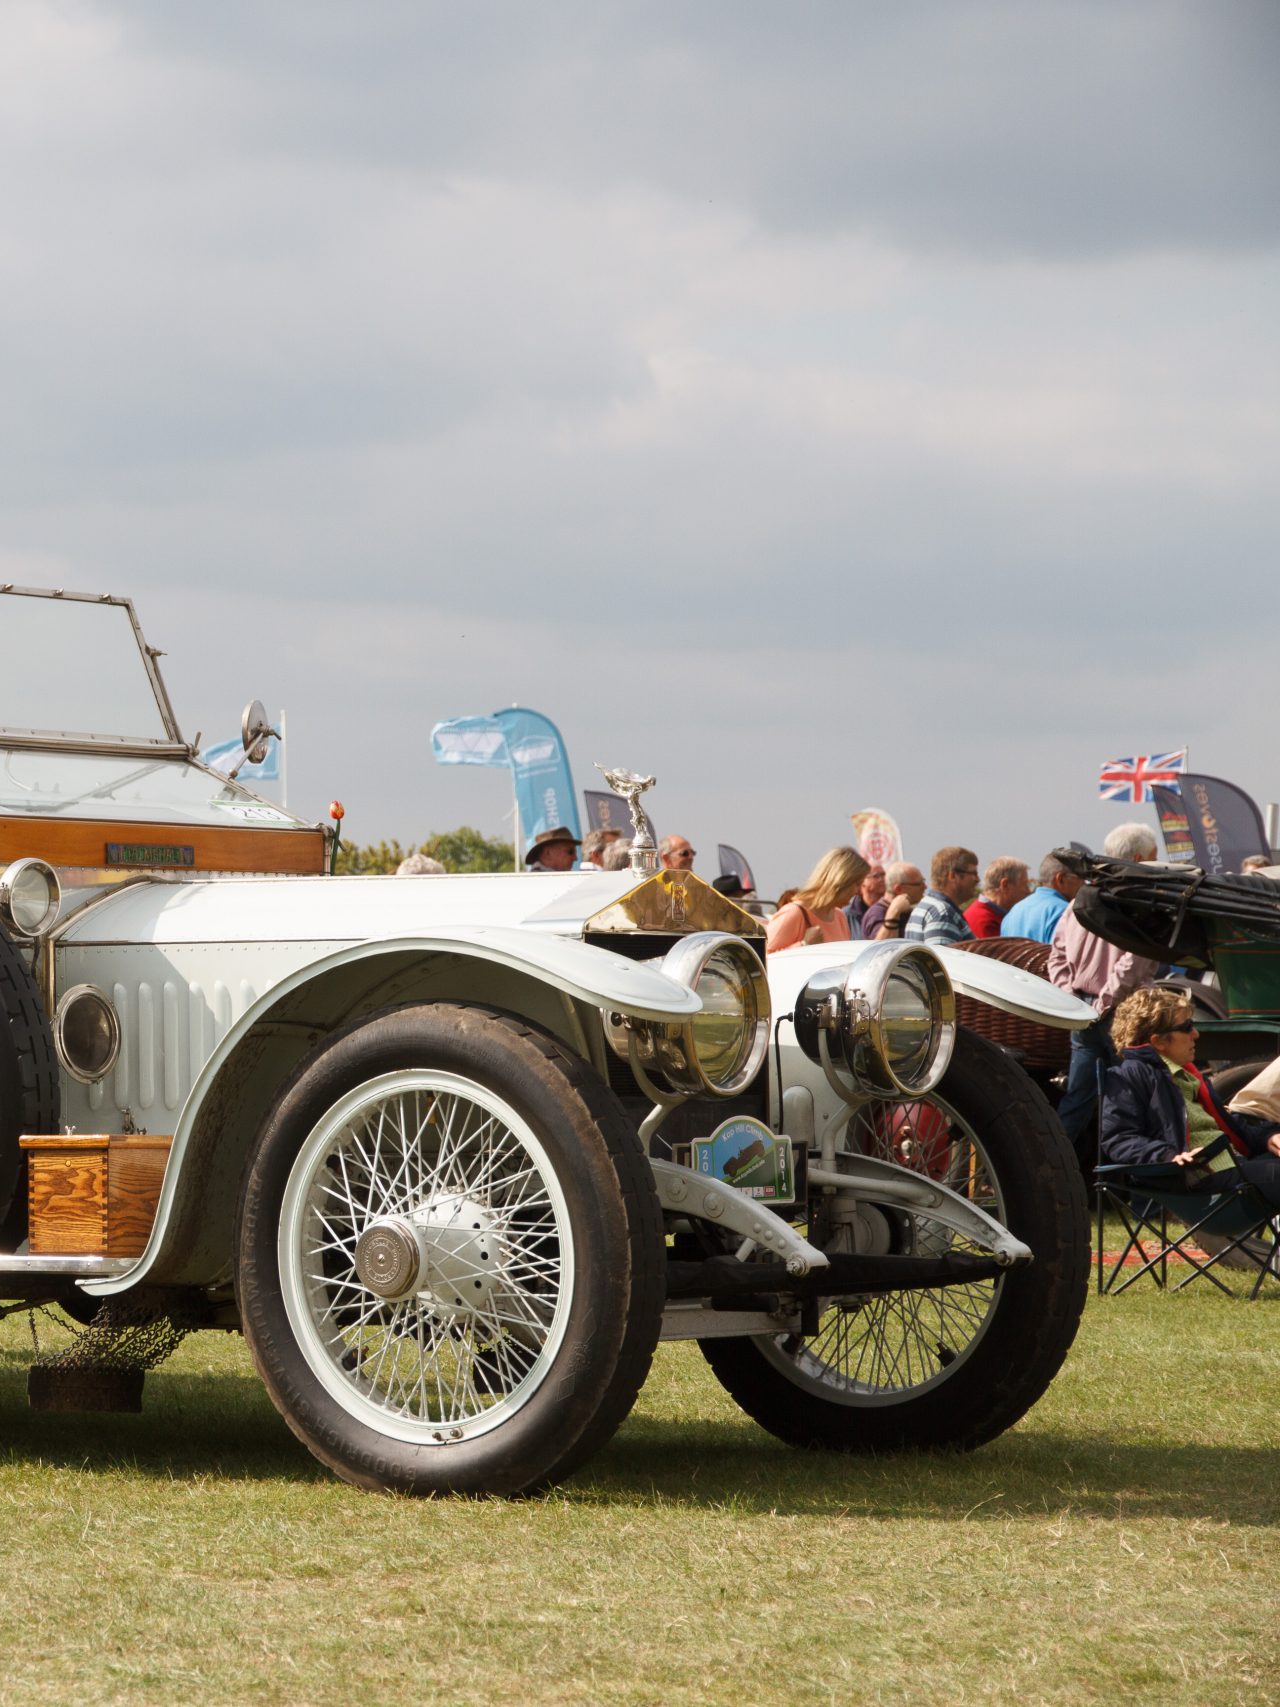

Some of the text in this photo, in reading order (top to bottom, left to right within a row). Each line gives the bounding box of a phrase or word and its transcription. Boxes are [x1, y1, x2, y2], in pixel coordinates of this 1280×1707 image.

[722, 1123, 764, 1142] Kop Hill Climb
[779, 1147, 787, 1192] 2014
